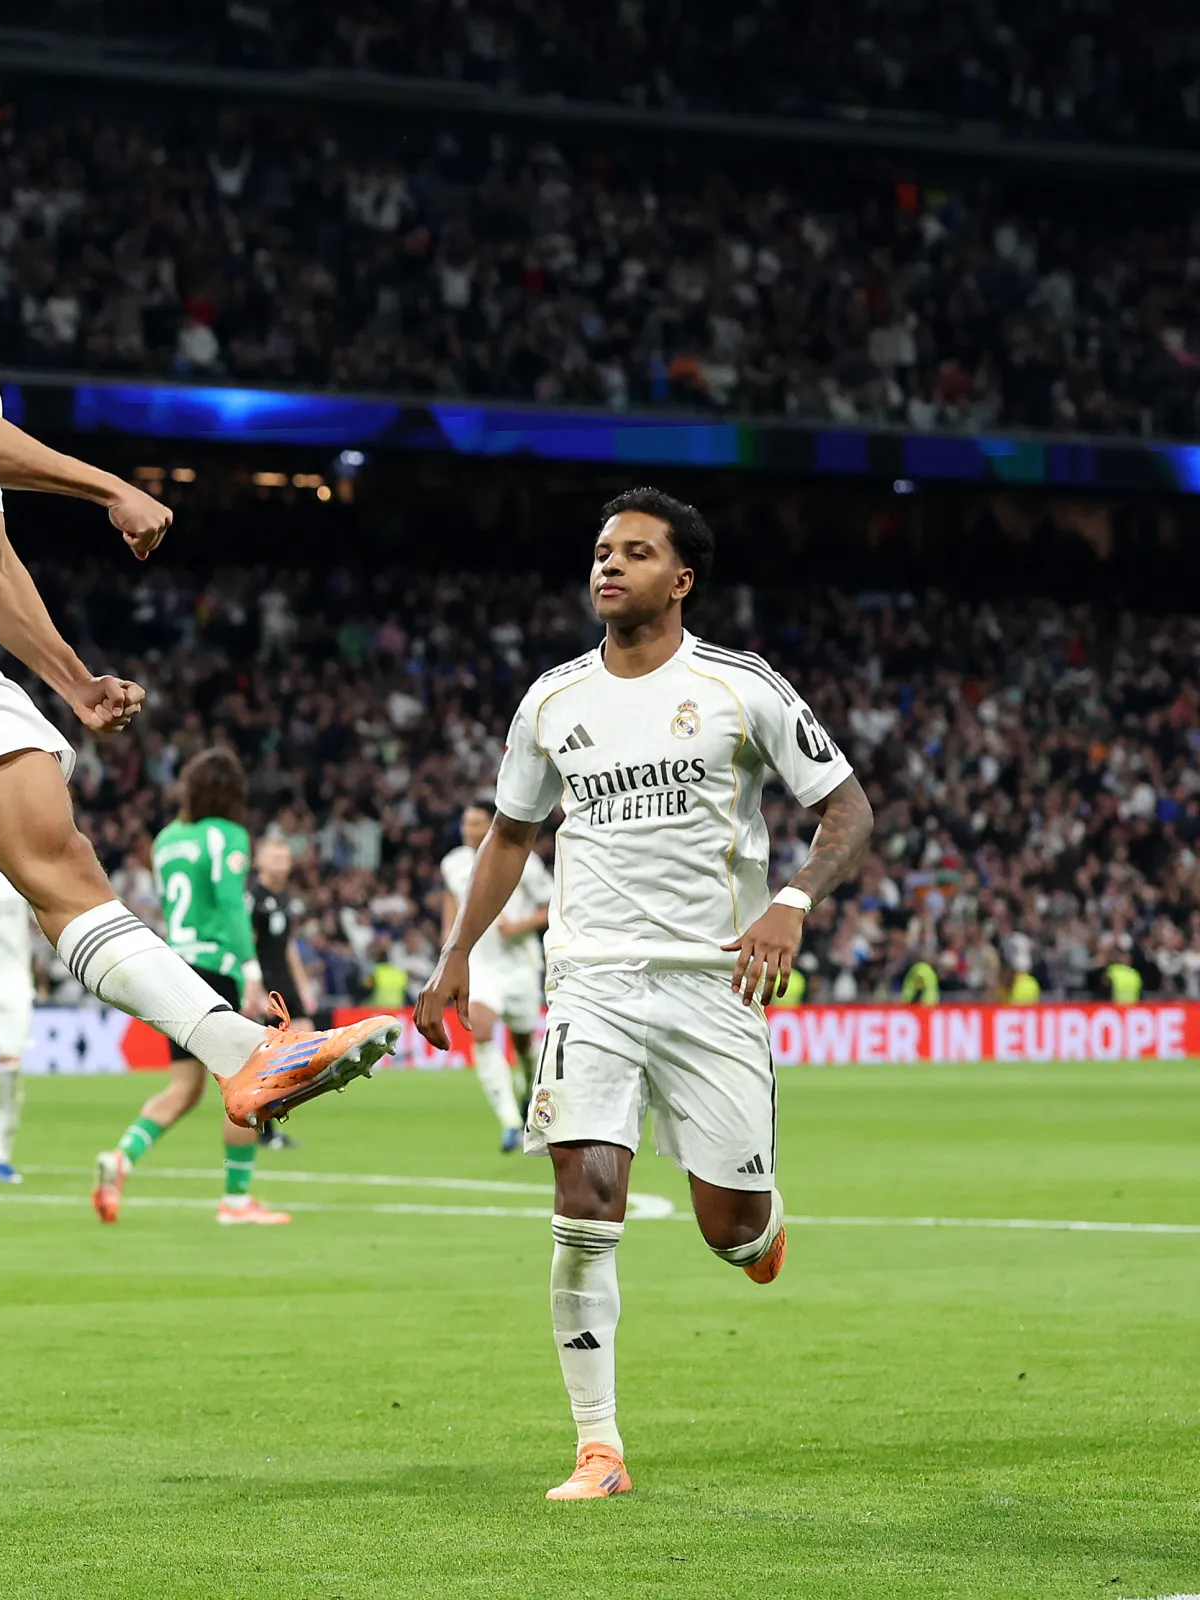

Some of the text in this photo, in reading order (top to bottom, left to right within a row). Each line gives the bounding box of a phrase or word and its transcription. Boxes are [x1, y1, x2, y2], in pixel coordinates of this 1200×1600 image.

[566, 757, 707, 802] Emirates
[590, 789, 688, 826] FLY BETTER
[167, 872, 197, 943] 2
[929, 1010, 982, 1062] IN
[992, 1007, 1187, 1062] EUROPE
